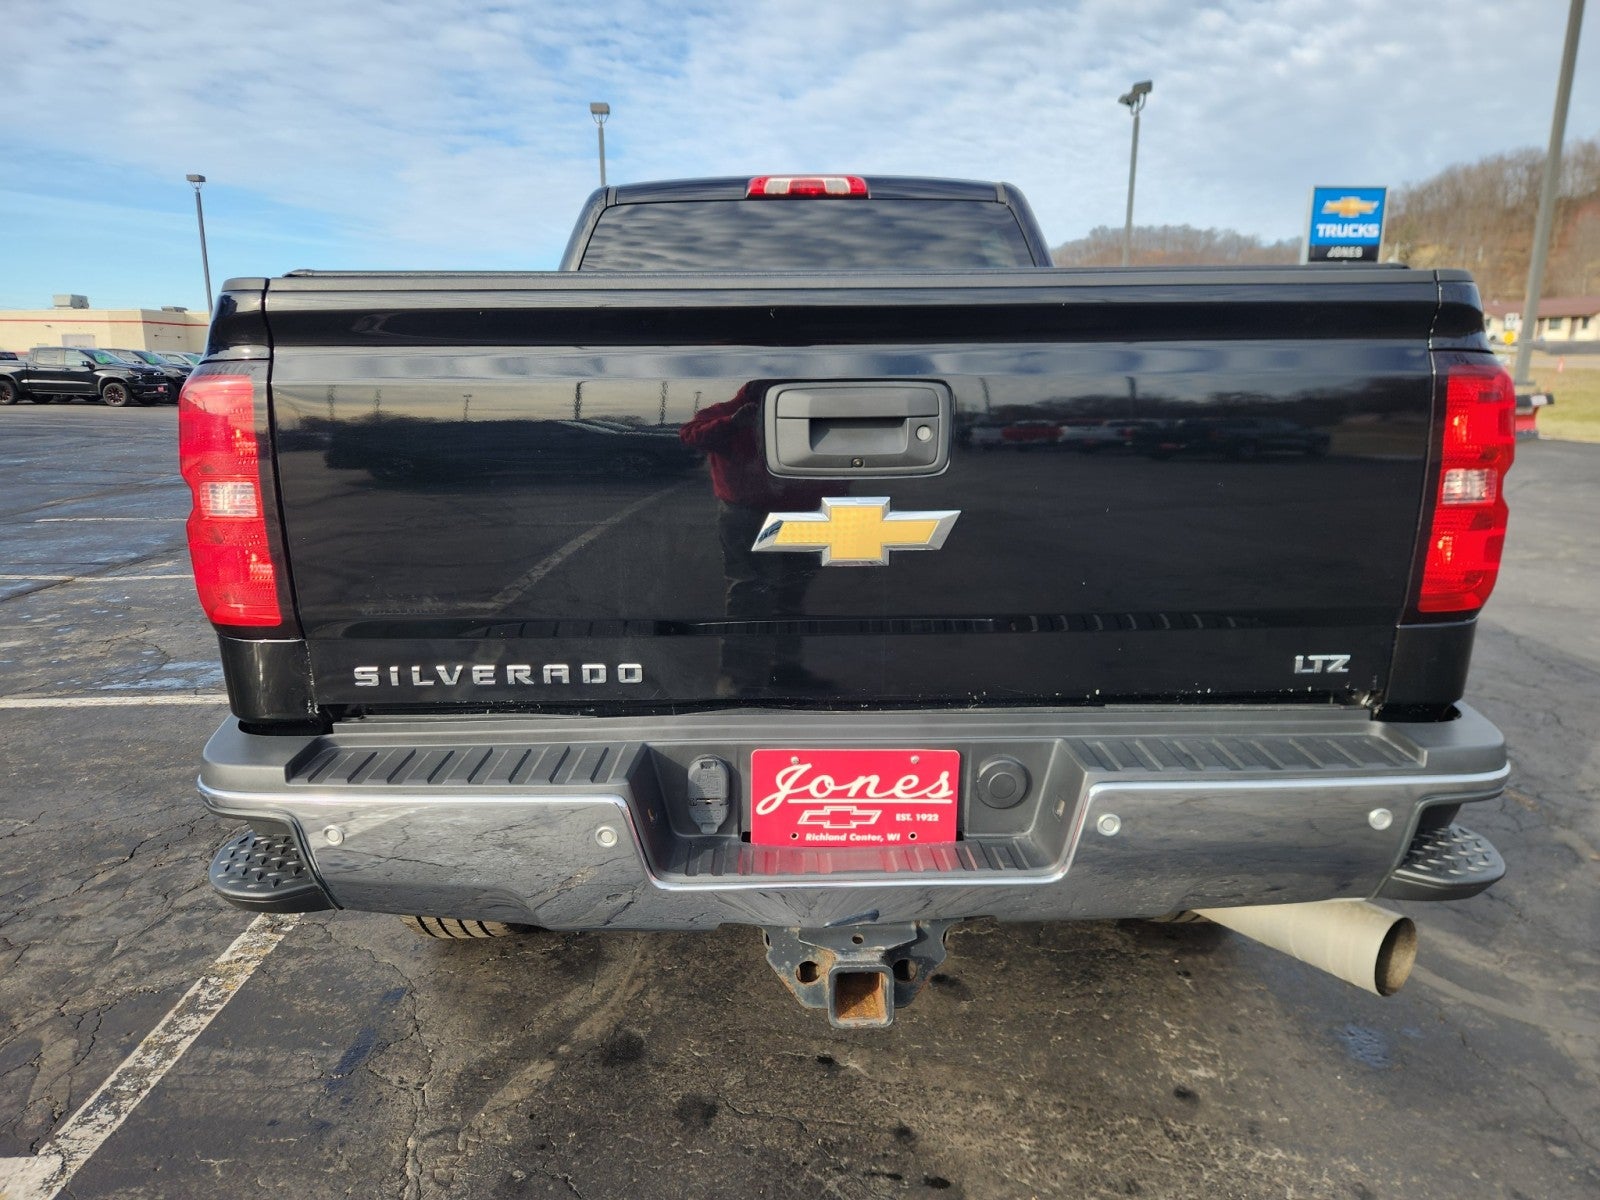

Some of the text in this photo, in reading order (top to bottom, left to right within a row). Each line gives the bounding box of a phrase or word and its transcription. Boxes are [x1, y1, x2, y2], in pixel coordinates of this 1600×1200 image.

[1316, 223, 1380, 238] TRUCKS
[1327, 246, 1363, 258] JONES
[1294, 654, 1350, 674] LTZ
[354, 663, 643, 687] SILVERADO
[756, 763, 954, 815] Jones
[895, 813, 940, 822] EST. 1922
[805, 832, 901, 843] Richland Center, WI
